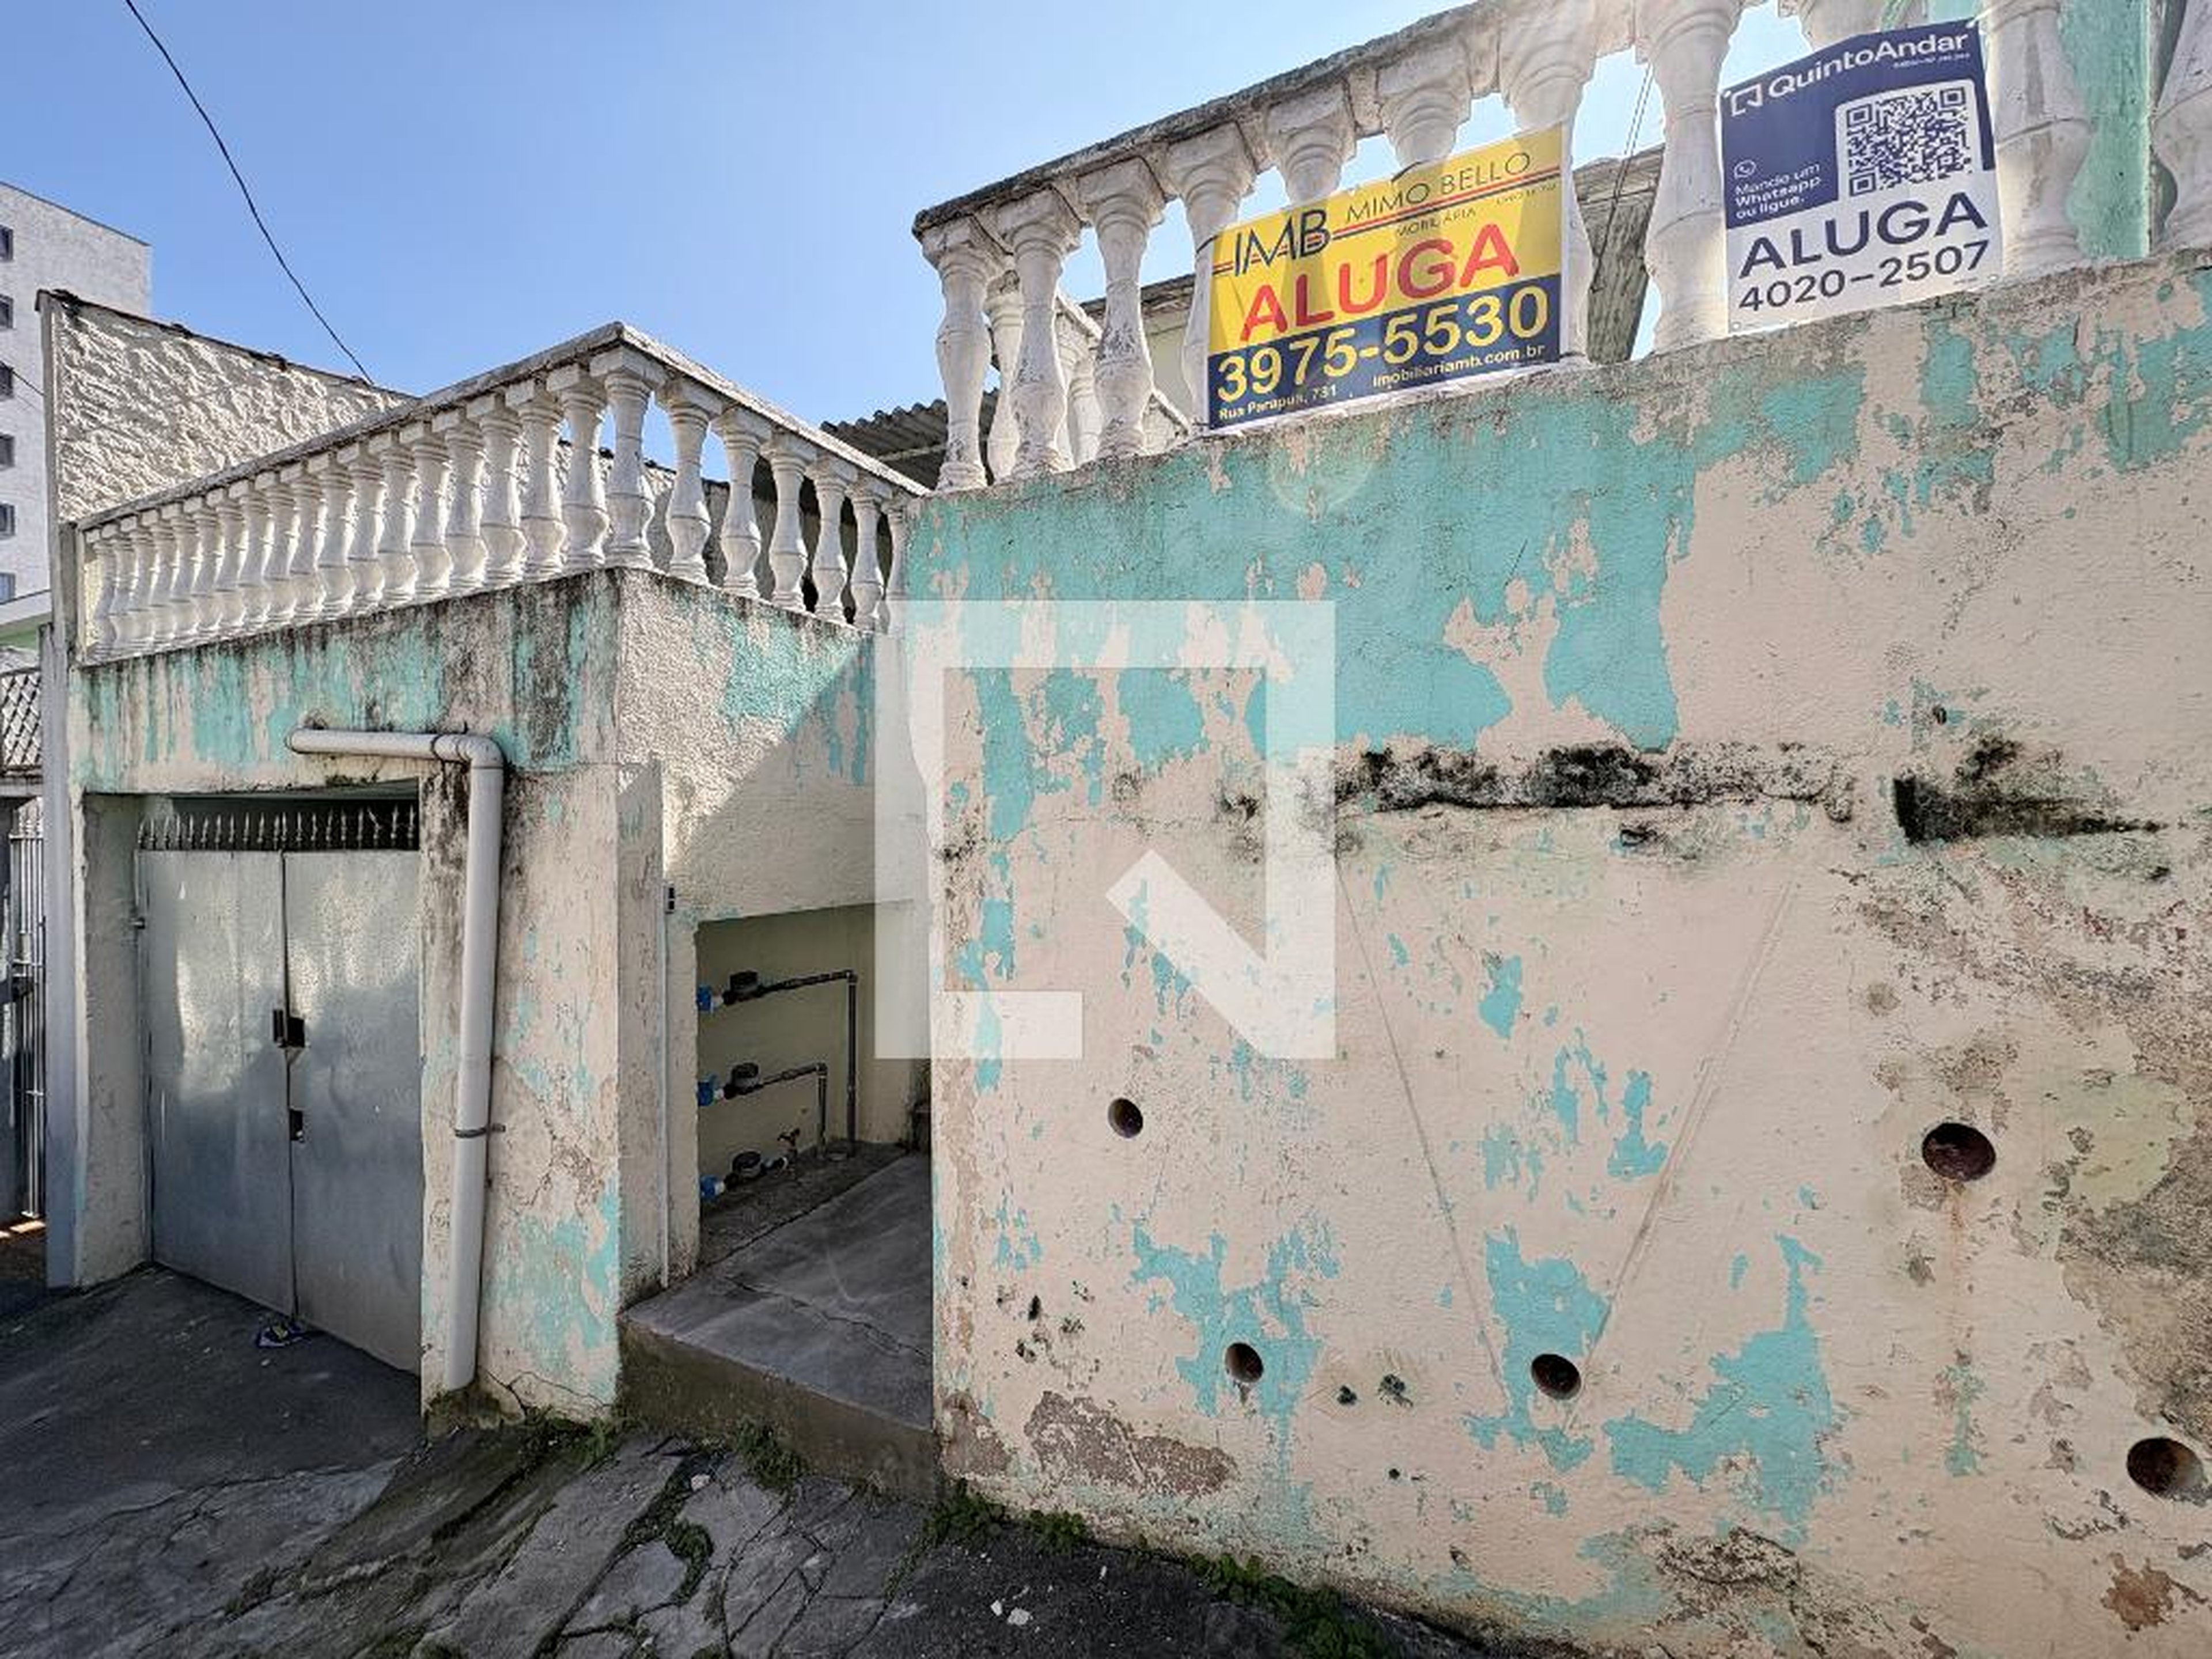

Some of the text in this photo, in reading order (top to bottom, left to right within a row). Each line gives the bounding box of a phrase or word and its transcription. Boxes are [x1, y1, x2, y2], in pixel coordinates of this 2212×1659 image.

[1768, 33, 1968, 98] QuintoAndar
[1346, 183, 1430, 223] MIMO
[1441, 152, 1530, 194] BELLO
[1734, 164, 1820, 195] Mando um
[1735, 176, 1822, 207] Whatsapp
[1736, 196, 1804, 218] ou ligue.
[1234, 209, 1332, 275] IMB
[1738, 192, 1987, 279] ALUGA
[1240, 224, 1520, 342] ALUGA
[1739, 240, 1988, 312] 4020-2507
[1217, 285, 1548, 403] 3975-5530
[1219, 407, 1245, 419] Rua
[1312, 384, 1336, 399] 731
